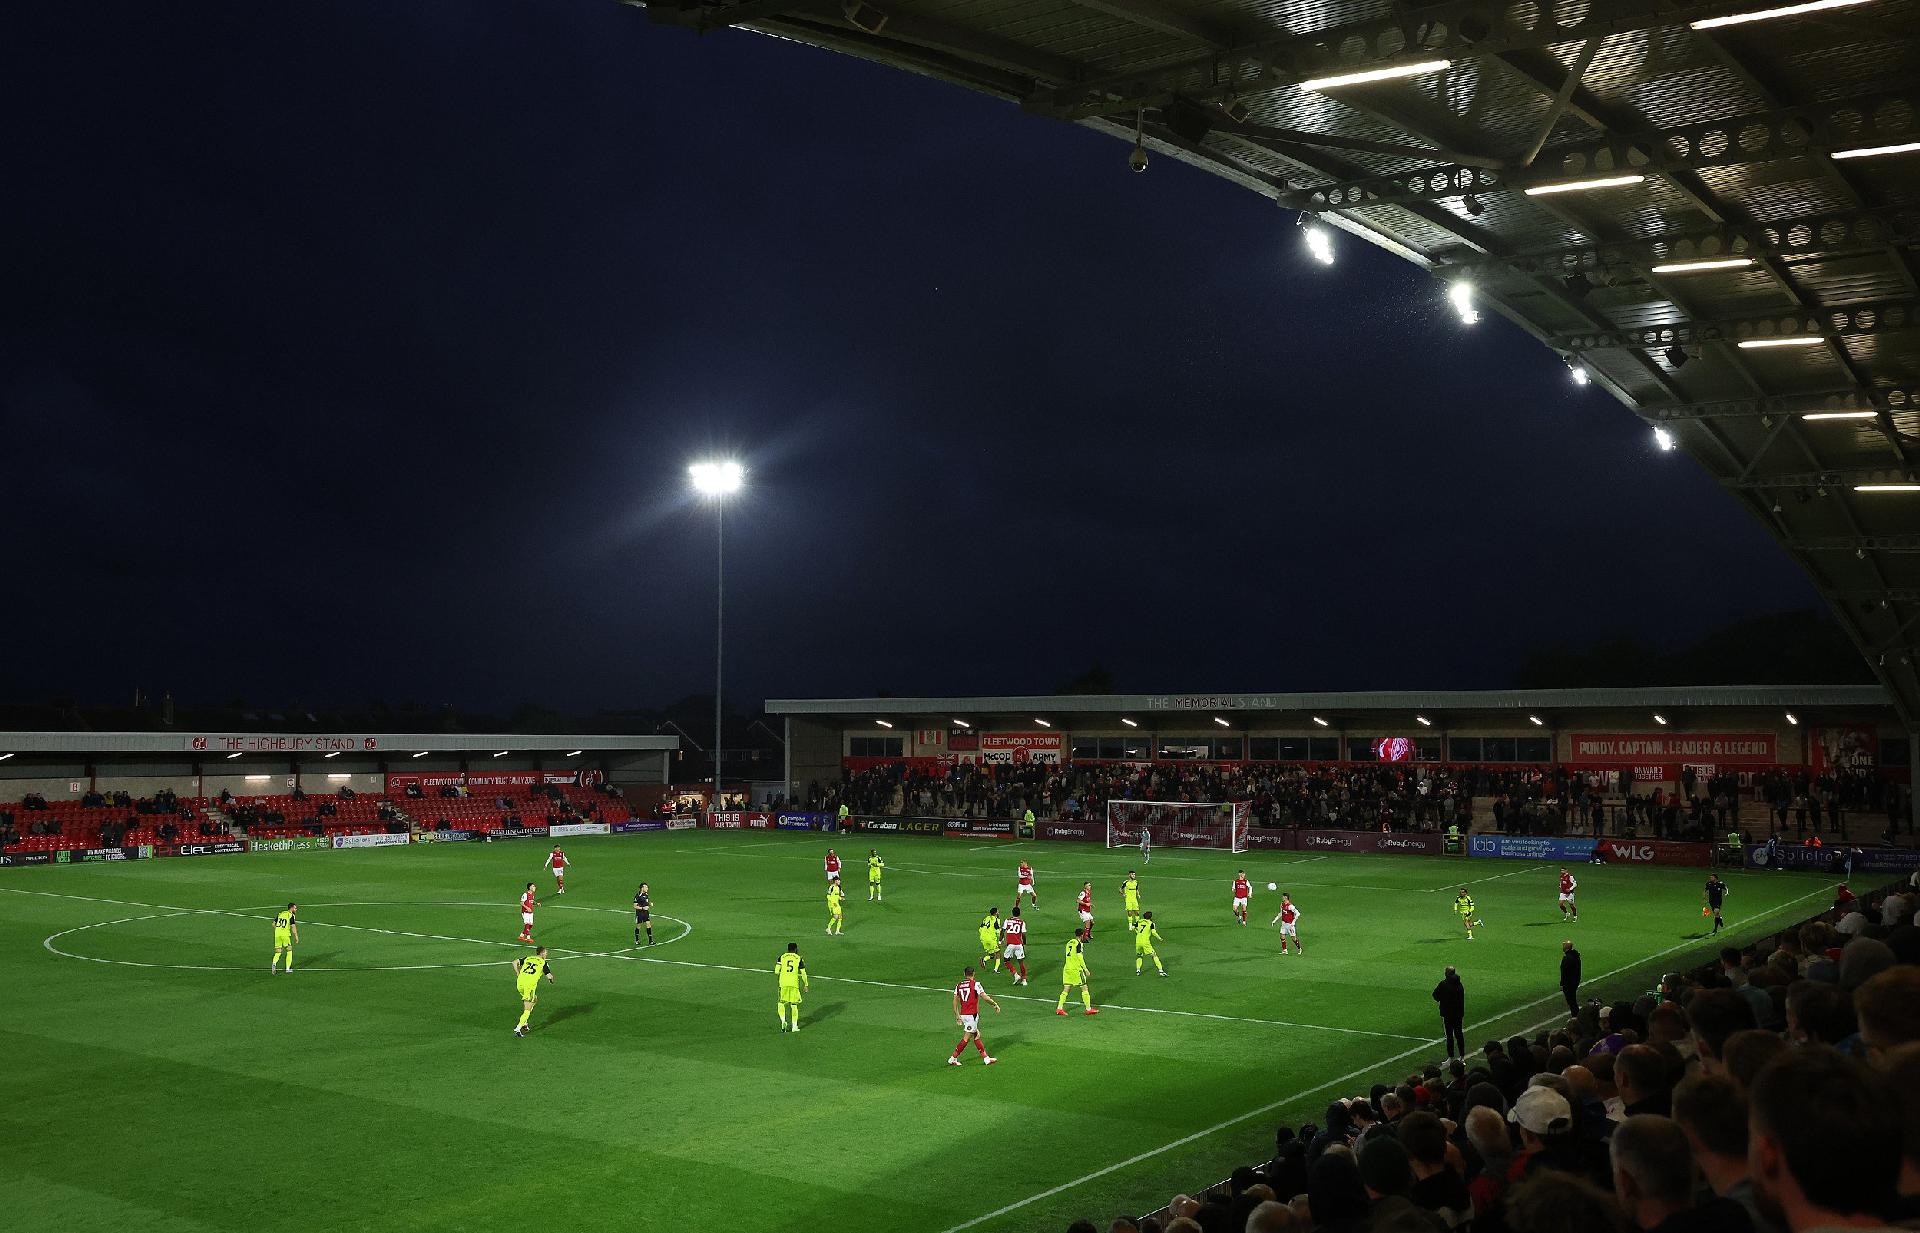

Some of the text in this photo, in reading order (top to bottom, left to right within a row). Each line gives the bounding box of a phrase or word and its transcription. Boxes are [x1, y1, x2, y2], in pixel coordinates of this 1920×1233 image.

[1147, 698, 1168, 709] THE
[1175, 697, 1235, 708] MEMORIAL
[219, 737, 243, 749] THE
[248, 738, 312, 750] HIGHBURY
[315, 738, 355, 750] STAND
[983, 737, 1032, 746] FLEETWOOD
[1034, 737, 1060, 746] TOWN
[1668, 741, 1711, 755] LEADER
[1712, 741, 1723, 755] &
[1724, 741, 1768, 755] LEGEND
[1032, 753, 1056, 762] ARMY
[714, 813, 740, 822] THIS IS
[867, 821, 898, 830] Carabao
[898, 822, 940, 832] LAGER
[1054, 828, 1085, 837] RubyEnergy
[1316, 836, 1352, 847] RubyEnergy
[1387, 839, 1426, 849] RubyEnergy
[1473, 837, 1496, 852] lab
[1612, 844, 1655, 861] WLG
[1006, 923, 1020, 934] 20
[1140, 924, 1147, 934] 7
[522, 963, 536, 974] 25
[787, 960, 794, 972] 5
[960, 987, 971, 1002] 17
